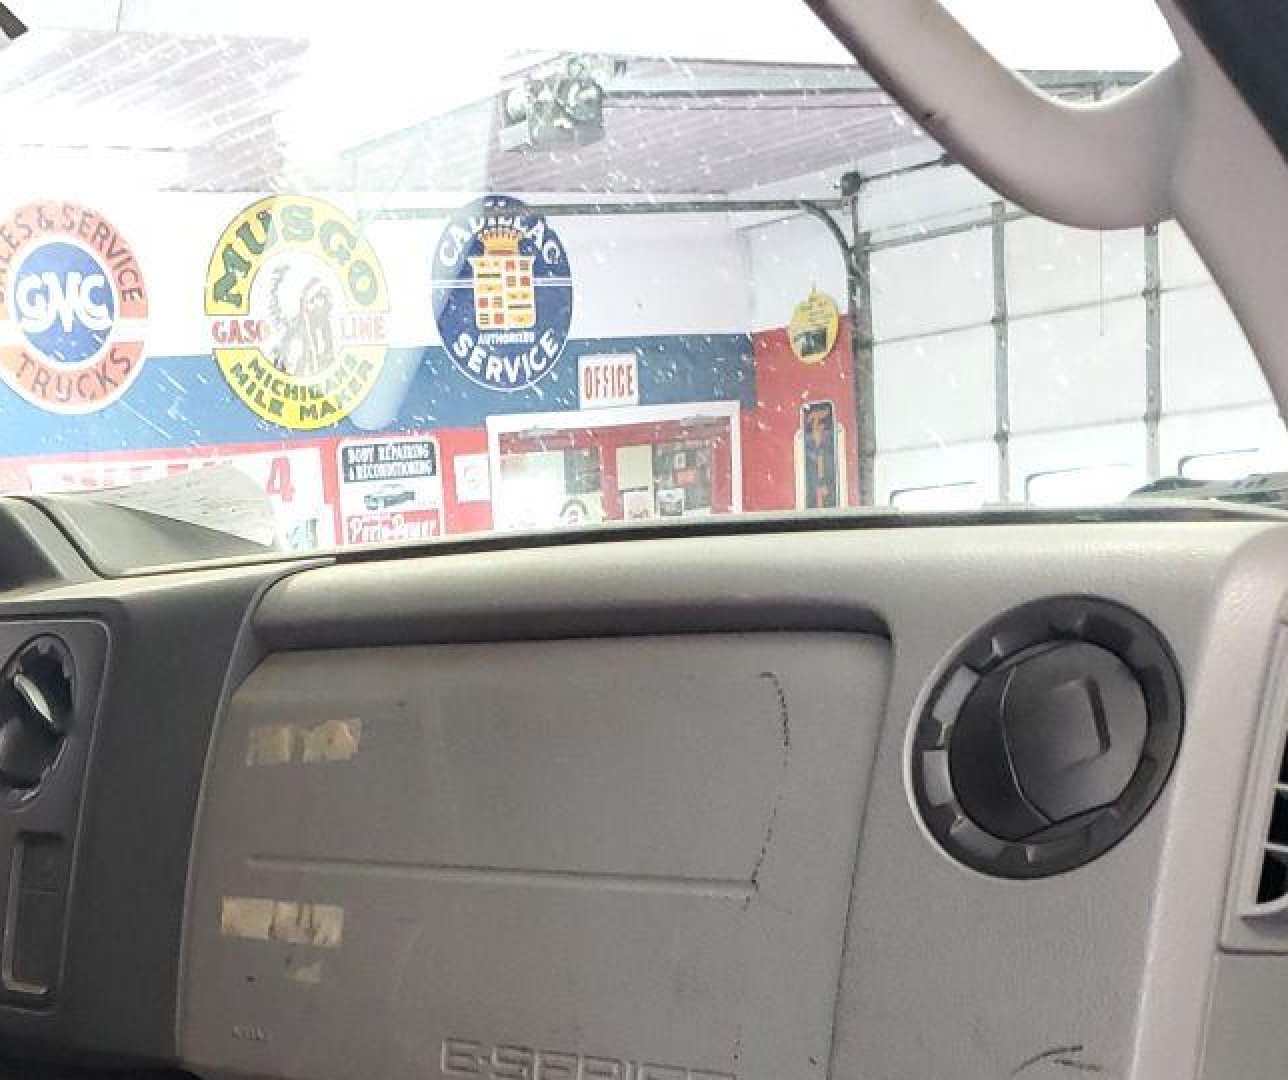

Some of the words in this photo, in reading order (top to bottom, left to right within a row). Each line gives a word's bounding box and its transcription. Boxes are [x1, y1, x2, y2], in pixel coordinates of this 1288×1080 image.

[36, 205, 55, 231] &
[61, 204, 143, 303] SERVICE
[213, 204, 379, 308] MUSGO
[439, 201, 562, 267] CADILLAC
[15, 271, 112, 333] GMC
[15, 348, 131, 403] TRUCKS
[453, 328, 559, 384] SERVICE
[583, 364, 635, 400] OFFICE
